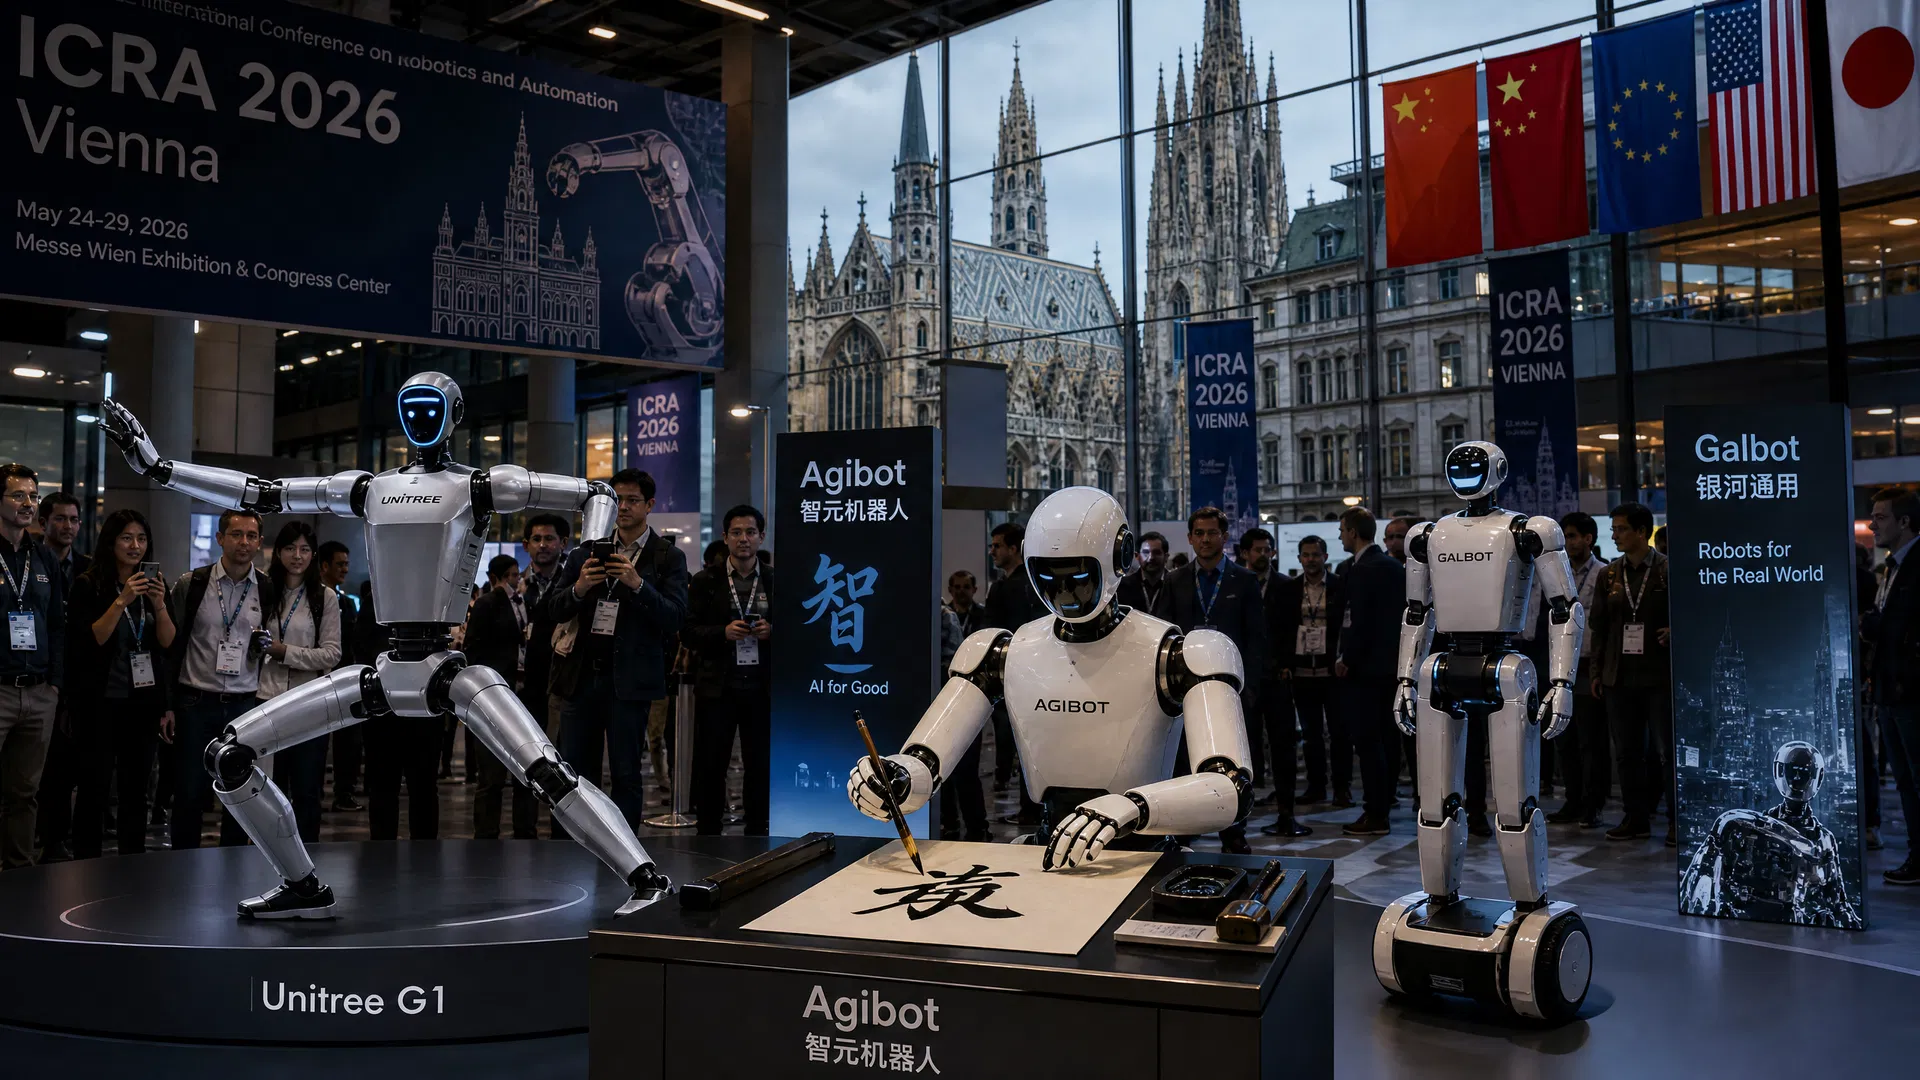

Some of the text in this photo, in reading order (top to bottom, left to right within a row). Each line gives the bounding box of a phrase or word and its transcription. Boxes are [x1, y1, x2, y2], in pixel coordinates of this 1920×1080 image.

[19, 13, 401, 145] ICRA 2026
[260, 19, 364, 56] Conference
[369, 47, 393, 64] on
[481, 70, 515, 89] and
[519, 76, 618, 113] Automation
[16, 97, 219, 183] Vienna
[17, 199, 189, 240] May 24-29, 2026
[16, 231, 392, 295] Messe Wien Exhibition & Congress Center
[1498, 286, 1564, 320] ICRA
[1499, 323, 1564, 356] 2026
[1194, 351, 1248, 377] ICRA
[1500, 360, 1567, 384] VIENNA
[637, 392, 680, 416] ICRA
[1195, 381, 1249, 406] 2026
[637, 416, 680, 440] 2026
[1195, 411, 1249, 429] VIENNA
[637, 440, 679, 456] VIENNA
[1694, 433, 1801, 463] Galbot
[799, 458, 906, 496] Agibot
[1695, 473, 1799, 501] 银河通用
[800, 497, 909, 523] 智元机器人
[1437, 551, 1494, 563] GALBOT
[1698, 540, 1792, 559] Robots for
[1698, 564, 1824, 585] the Real World
[801, 553, 879, 653] 智
[808, 679, 889, 695] AI for Good
[1034, 698, 1110, 714] AGIBOT
[262, 981, 444, 1015] Unitree G1
[802, 985, 940, 1032] Agibot
[805, 1031, 941, 1075] 智元机器人
